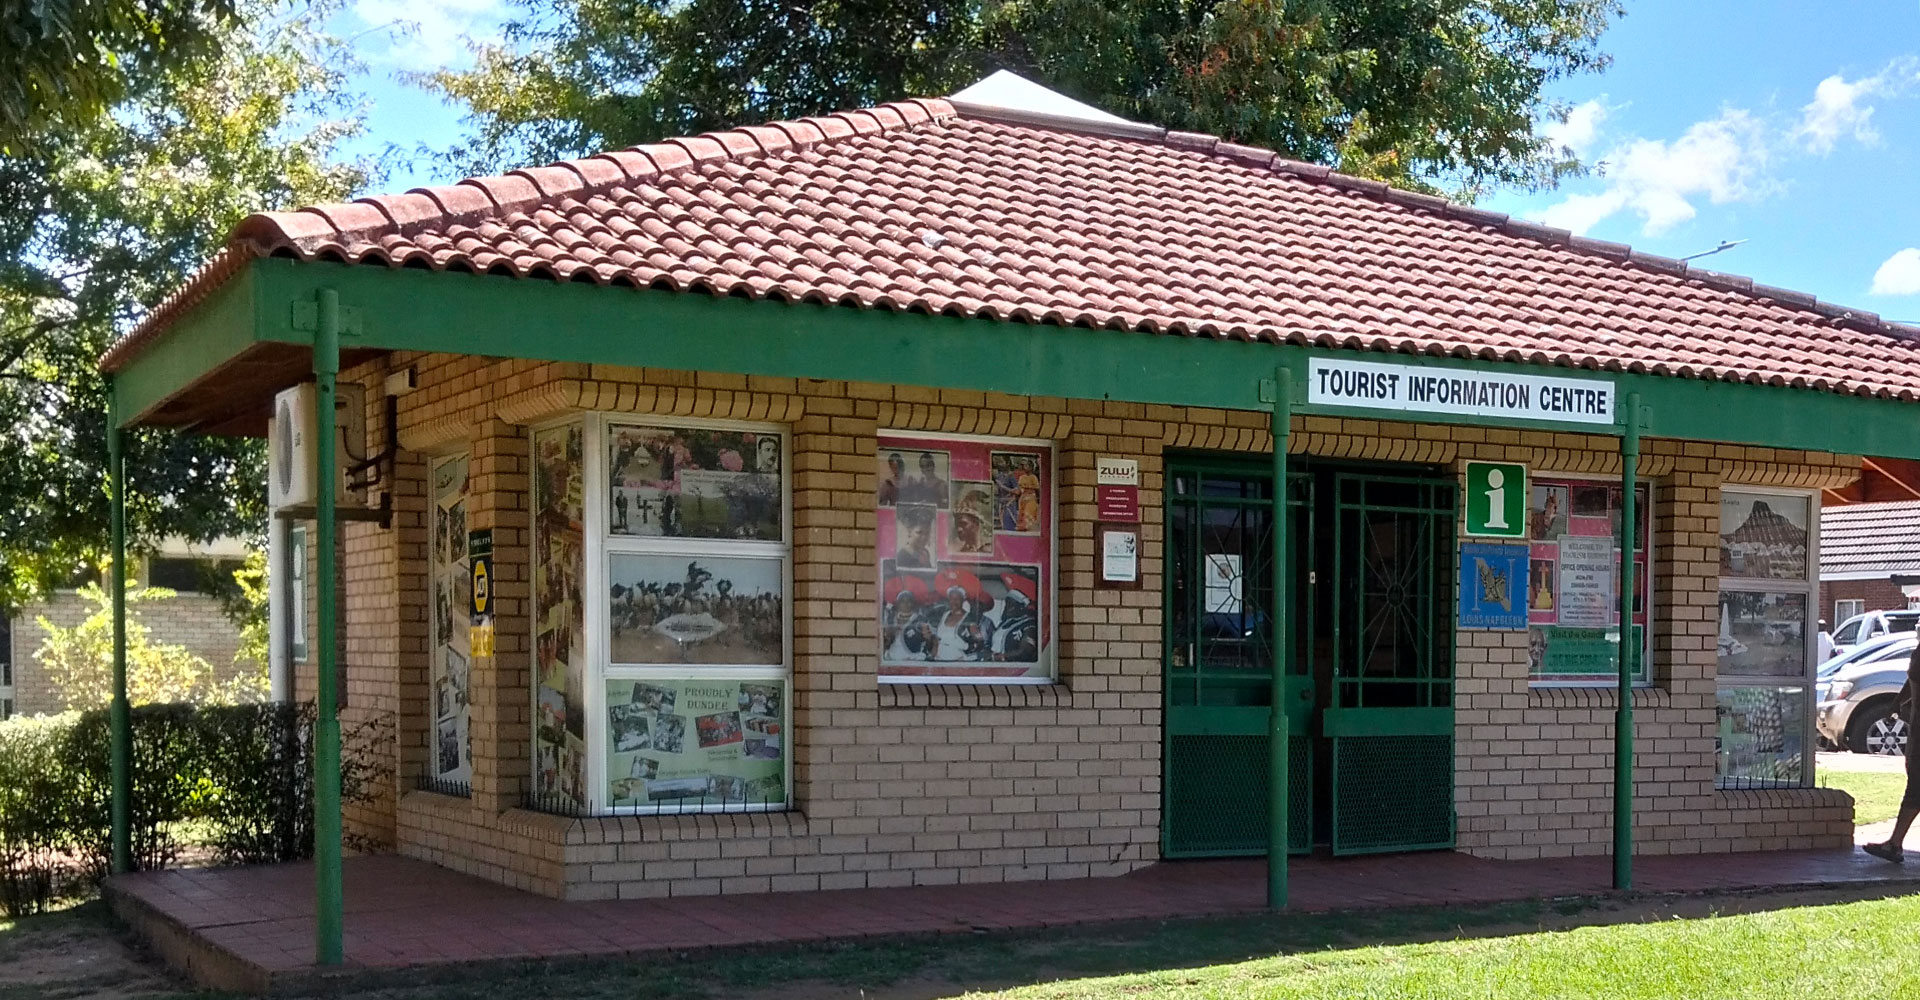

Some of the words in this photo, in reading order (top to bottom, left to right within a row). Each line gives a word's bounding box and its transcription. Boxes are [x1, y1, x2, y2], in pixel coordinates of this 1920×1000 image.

[1317, 368, 1400, 400] TOURIST
[1408, 376, 1530, 410] INFORMATION
[1539, 385, 1607, 415] CENTRE
[1100, 466, 1130, 475] ZULU
[684, 687, 733, 699] PROUDLY
[687, 700, 729, 711] DUNDEE
